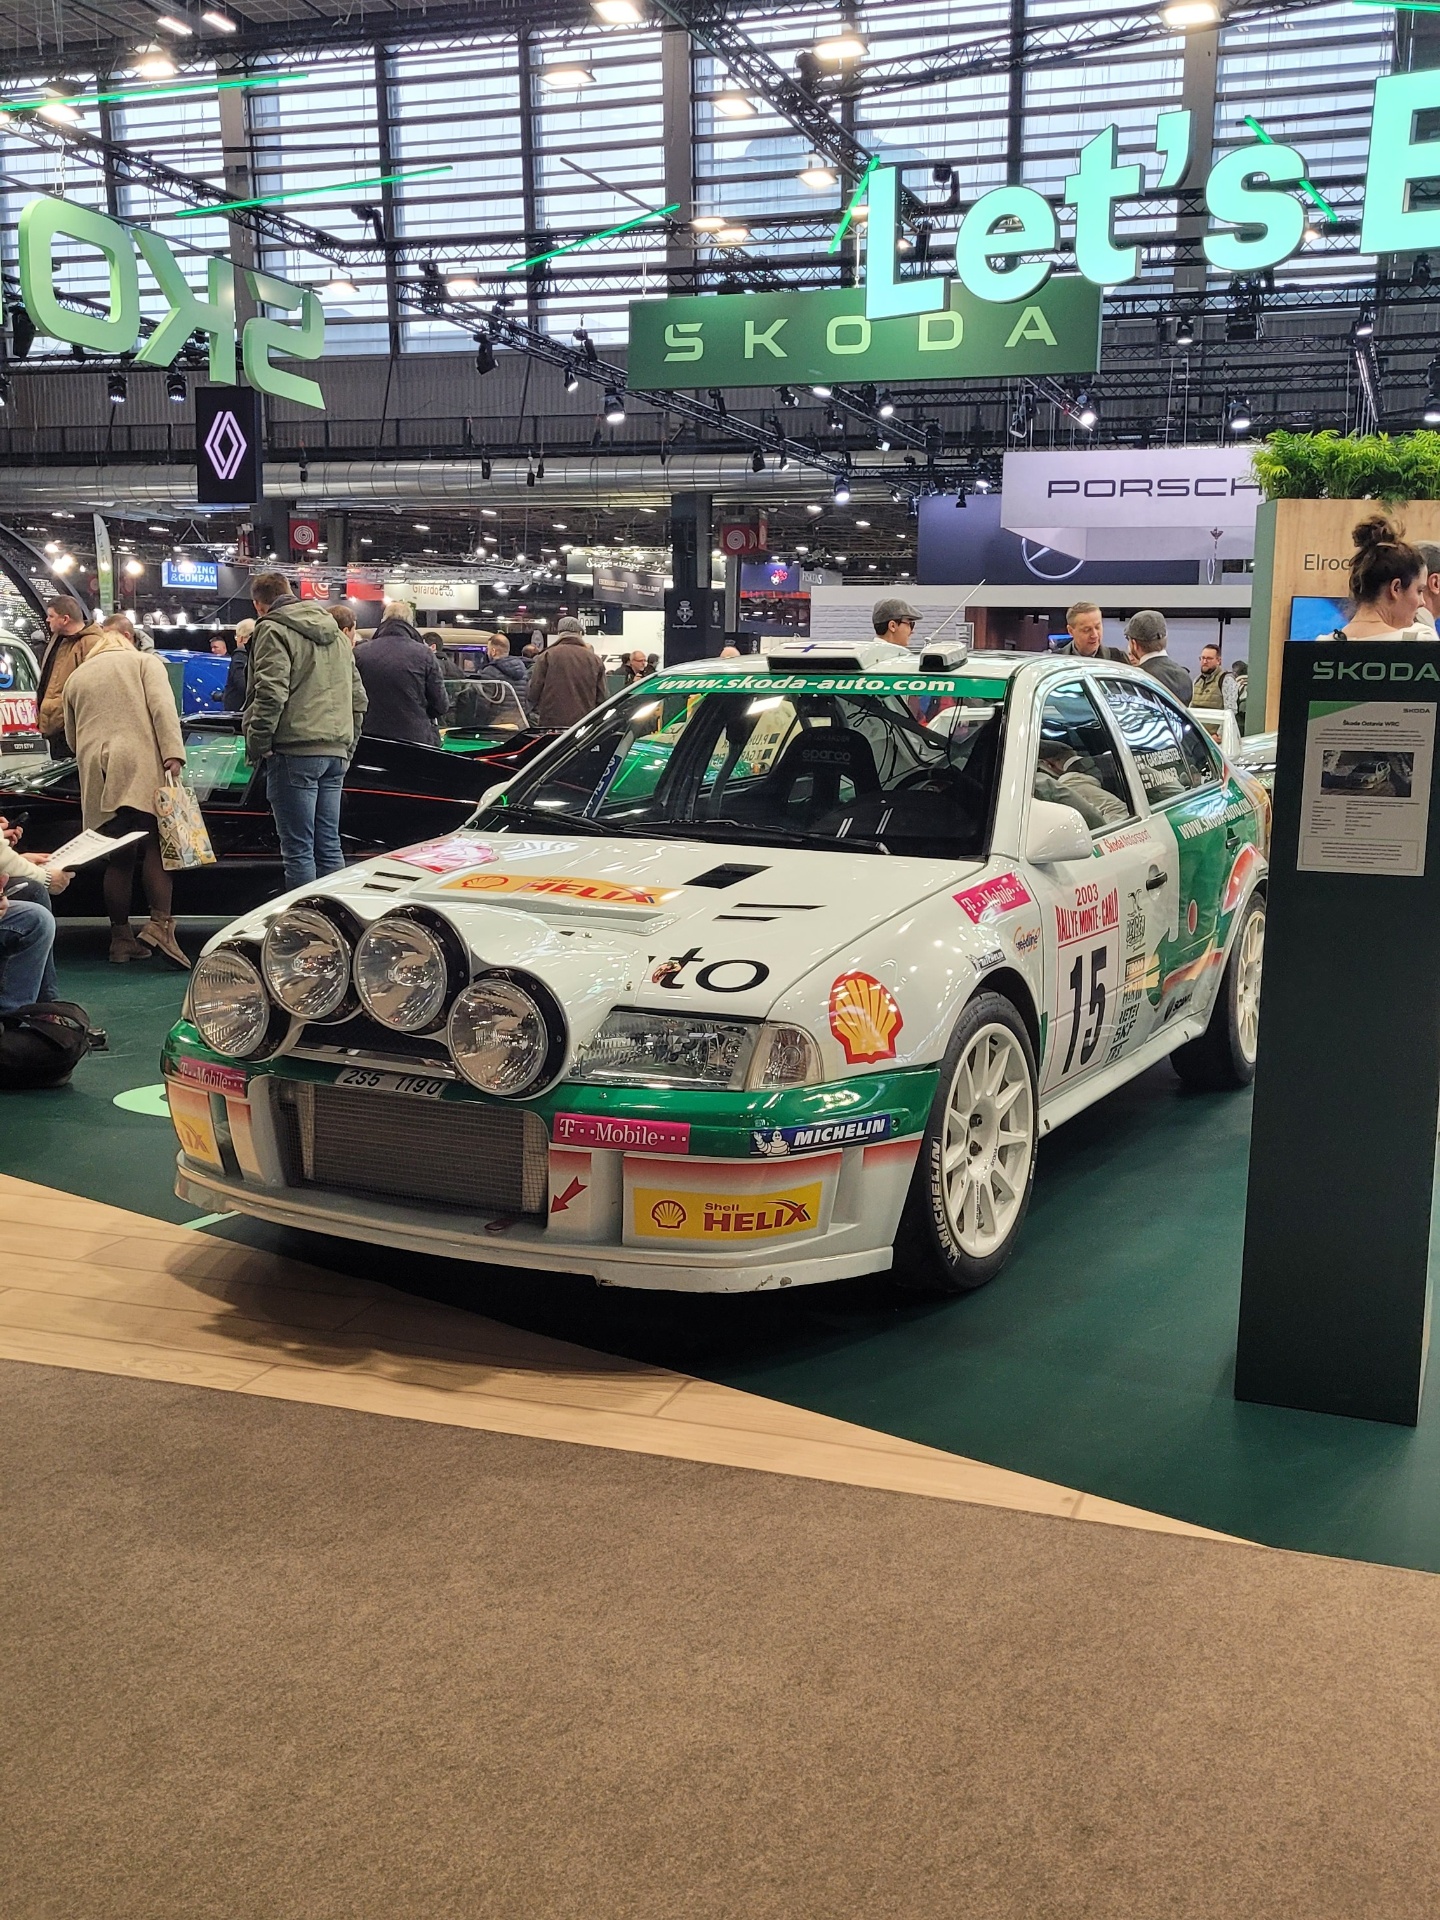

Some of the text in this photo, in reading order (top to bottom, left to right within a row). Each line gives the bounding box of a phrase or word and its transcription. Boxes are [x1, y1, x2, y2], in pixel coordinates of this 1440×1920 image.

[866, 110, 1308, 320] Let's
[655, 675, 955, 692] www.skoda-auto.com
[514, 882, 659, 904] HELIX
[1075, 883, 1099, 907] 2003
[1055, 904, 1079, 943] RALLYE
[1062, 946, 1107, 1076] 15
[342, 1069, 443, 1095] 2S5 1190
[793, 1117, 886, 1147] MICHELIN
[703, 1199, 811, 1233] HELIX
[704, 1202, 740, 1213] Shell
